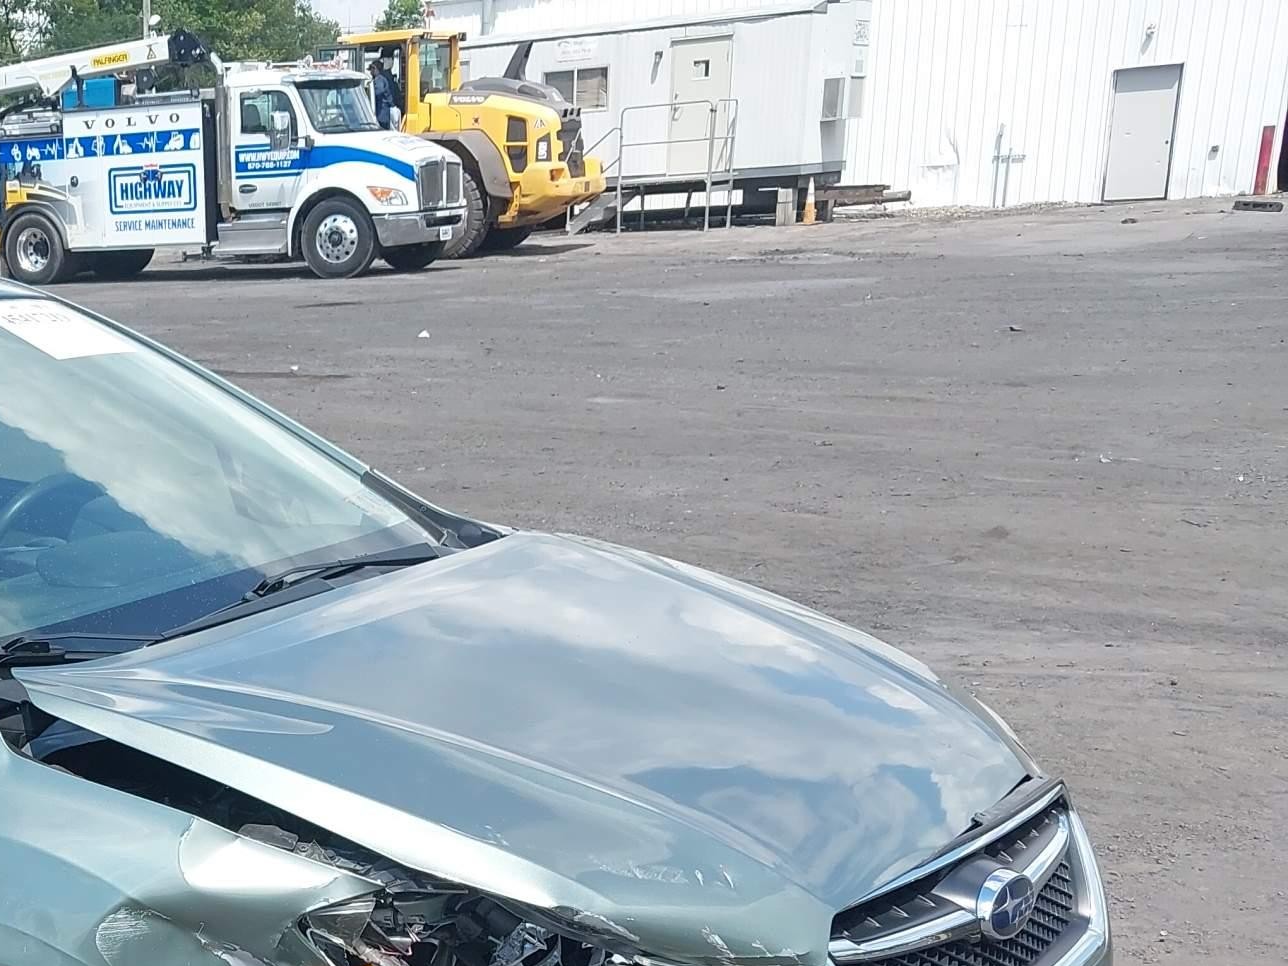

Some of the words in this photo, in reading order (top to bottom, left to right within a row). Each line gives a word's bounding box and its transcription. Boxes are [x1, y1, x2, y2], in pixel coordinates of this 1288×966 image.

[452, 95, 485, 103] VOLVO
[82, 112, 180, 130] VOLVO
[120, 179, 184, 201] HIGHWAY
[115, 220, 143, 232] SERVICE
[145, 217, 196, 231] MAINTENANCE
